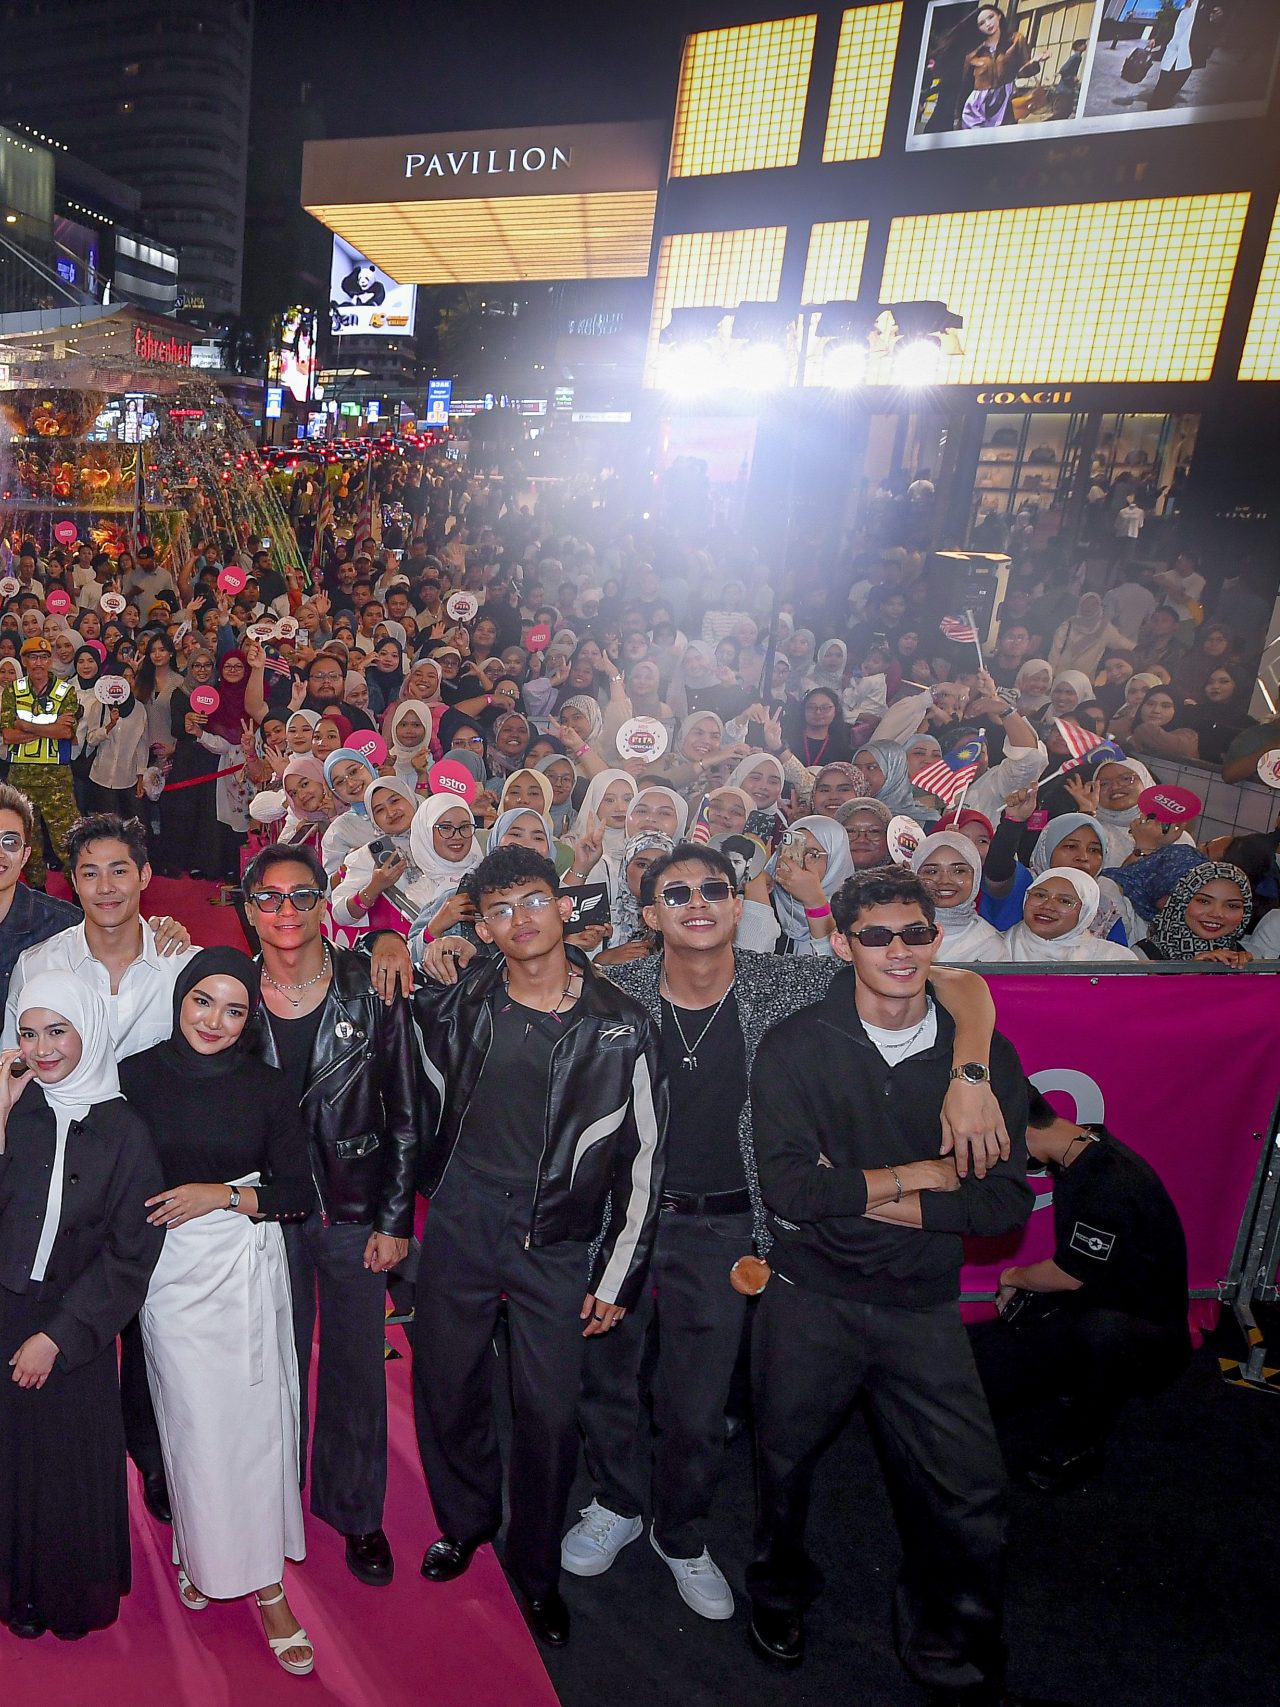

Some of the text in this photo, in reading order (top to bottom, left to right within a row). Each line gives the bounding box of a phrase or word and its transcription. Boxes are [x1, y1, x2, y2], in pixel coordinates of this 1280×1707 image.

[405, 146, 573, 178] PAVILION
[135, 328, 190, 366] fahrenheit
[976, 392, 1072, 404] COACH
[196, 694, 214, 706] astro
[439, 774, 467, 794] astro
[1152, 793, 1186, 815] astro
